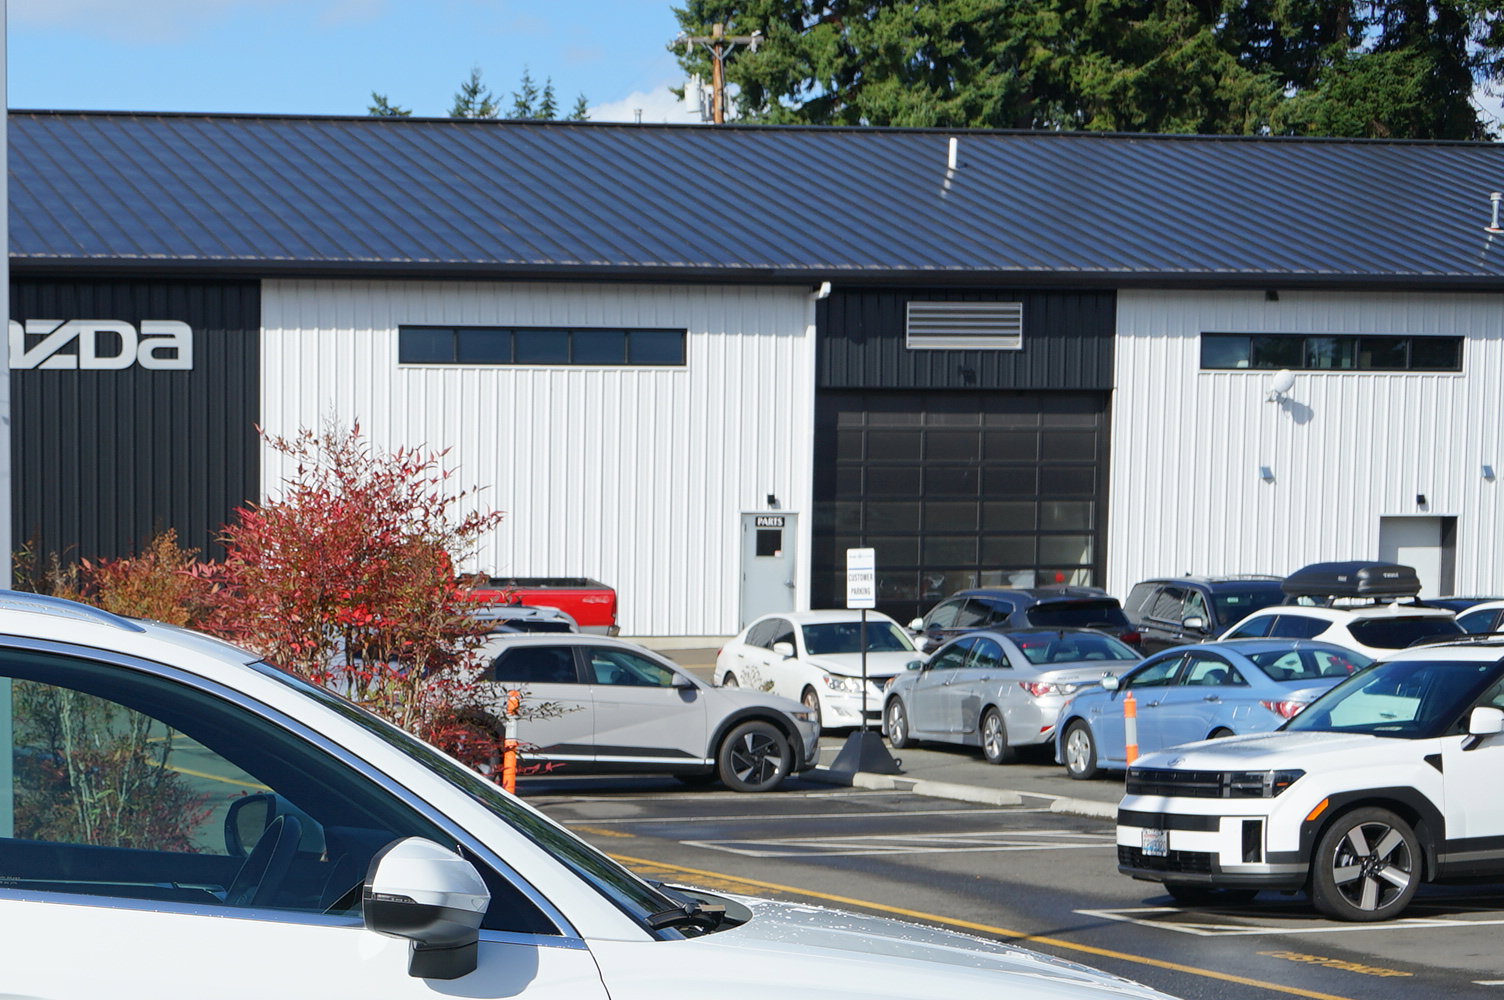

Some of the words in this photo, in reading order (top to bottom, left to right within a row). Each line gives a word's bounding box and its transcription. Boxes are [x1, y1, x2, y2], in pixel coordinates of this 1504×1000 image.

[757, 516, 783, 526] PARTS
[848, 573, 873, 582] CUSTOMER
[850, 587, 871, 596] PARKING
